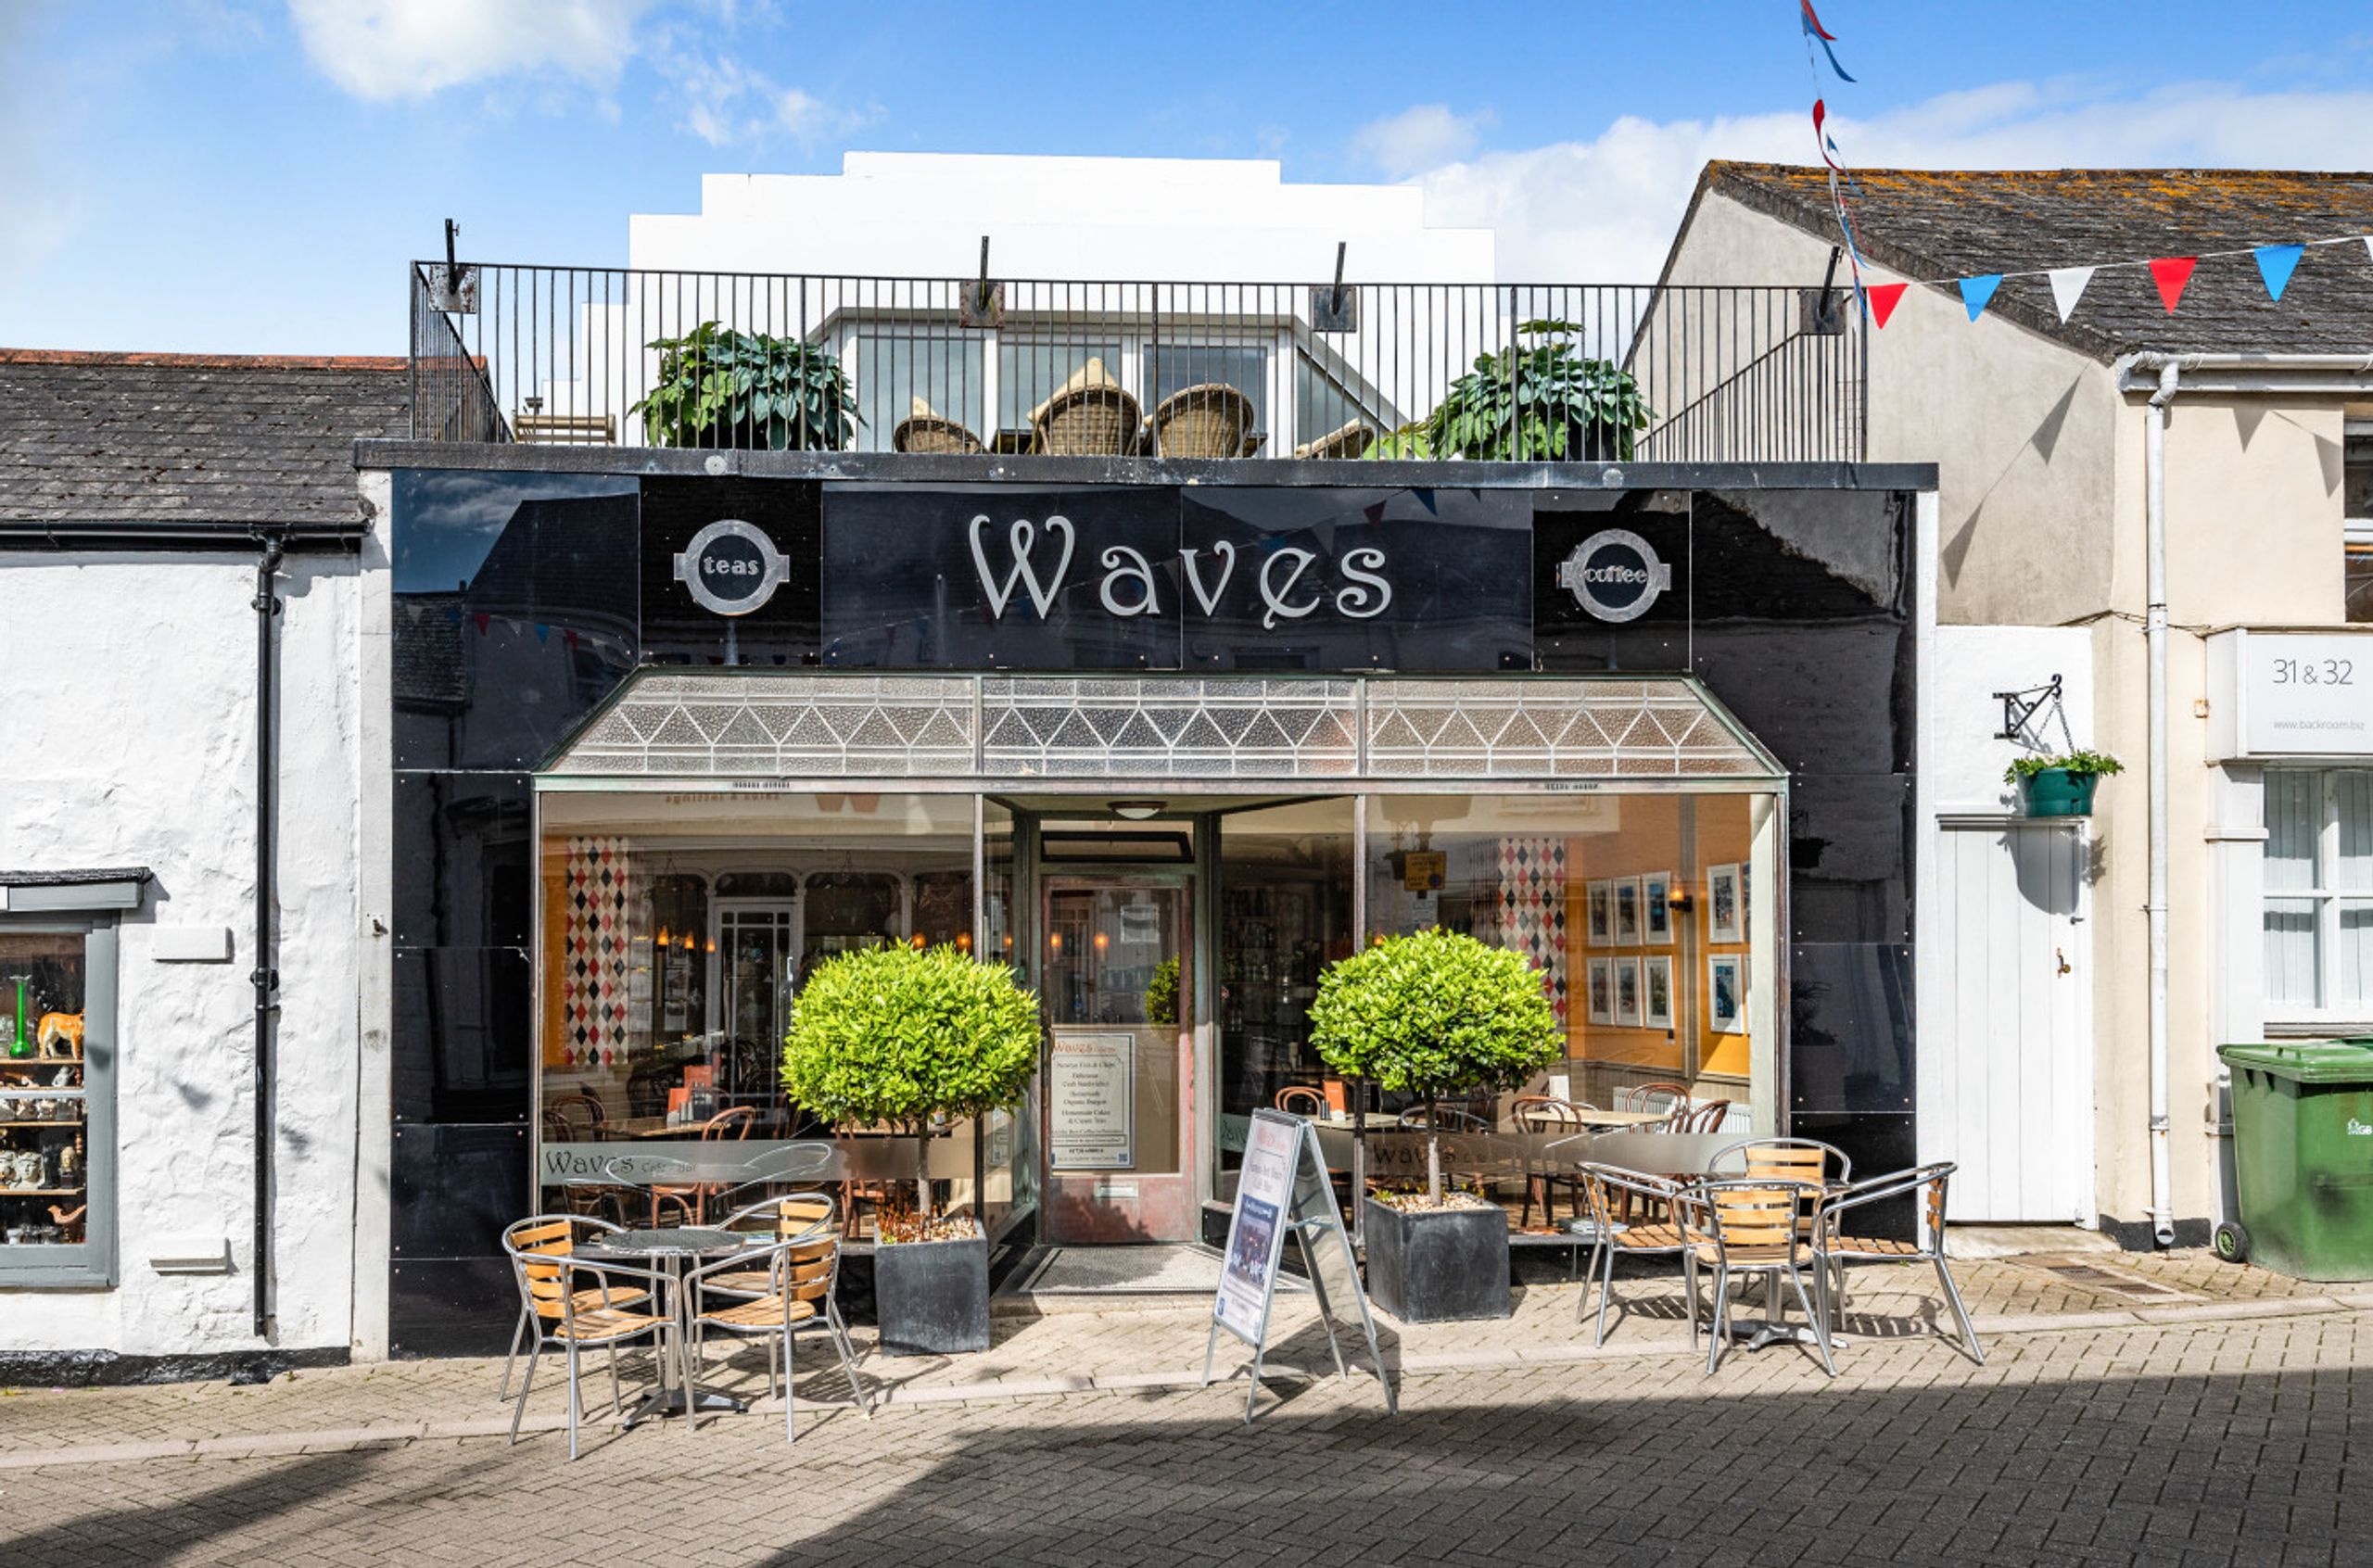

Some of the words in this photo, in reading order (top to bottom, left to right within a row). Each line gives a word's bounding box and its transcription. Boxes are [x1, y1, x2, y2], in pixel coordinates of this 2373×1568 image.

[703, 556, 760, 575] teas
[969, 512, 1391, 630] Waves
[1584, 564, 1648, 583] coffee
[2273, 659, 2297, 684] 31
[2303, 664, 2318, 685] &
[2323, 659, 2354, 685] 32
[545, 1149, 635, 1175] Waves
